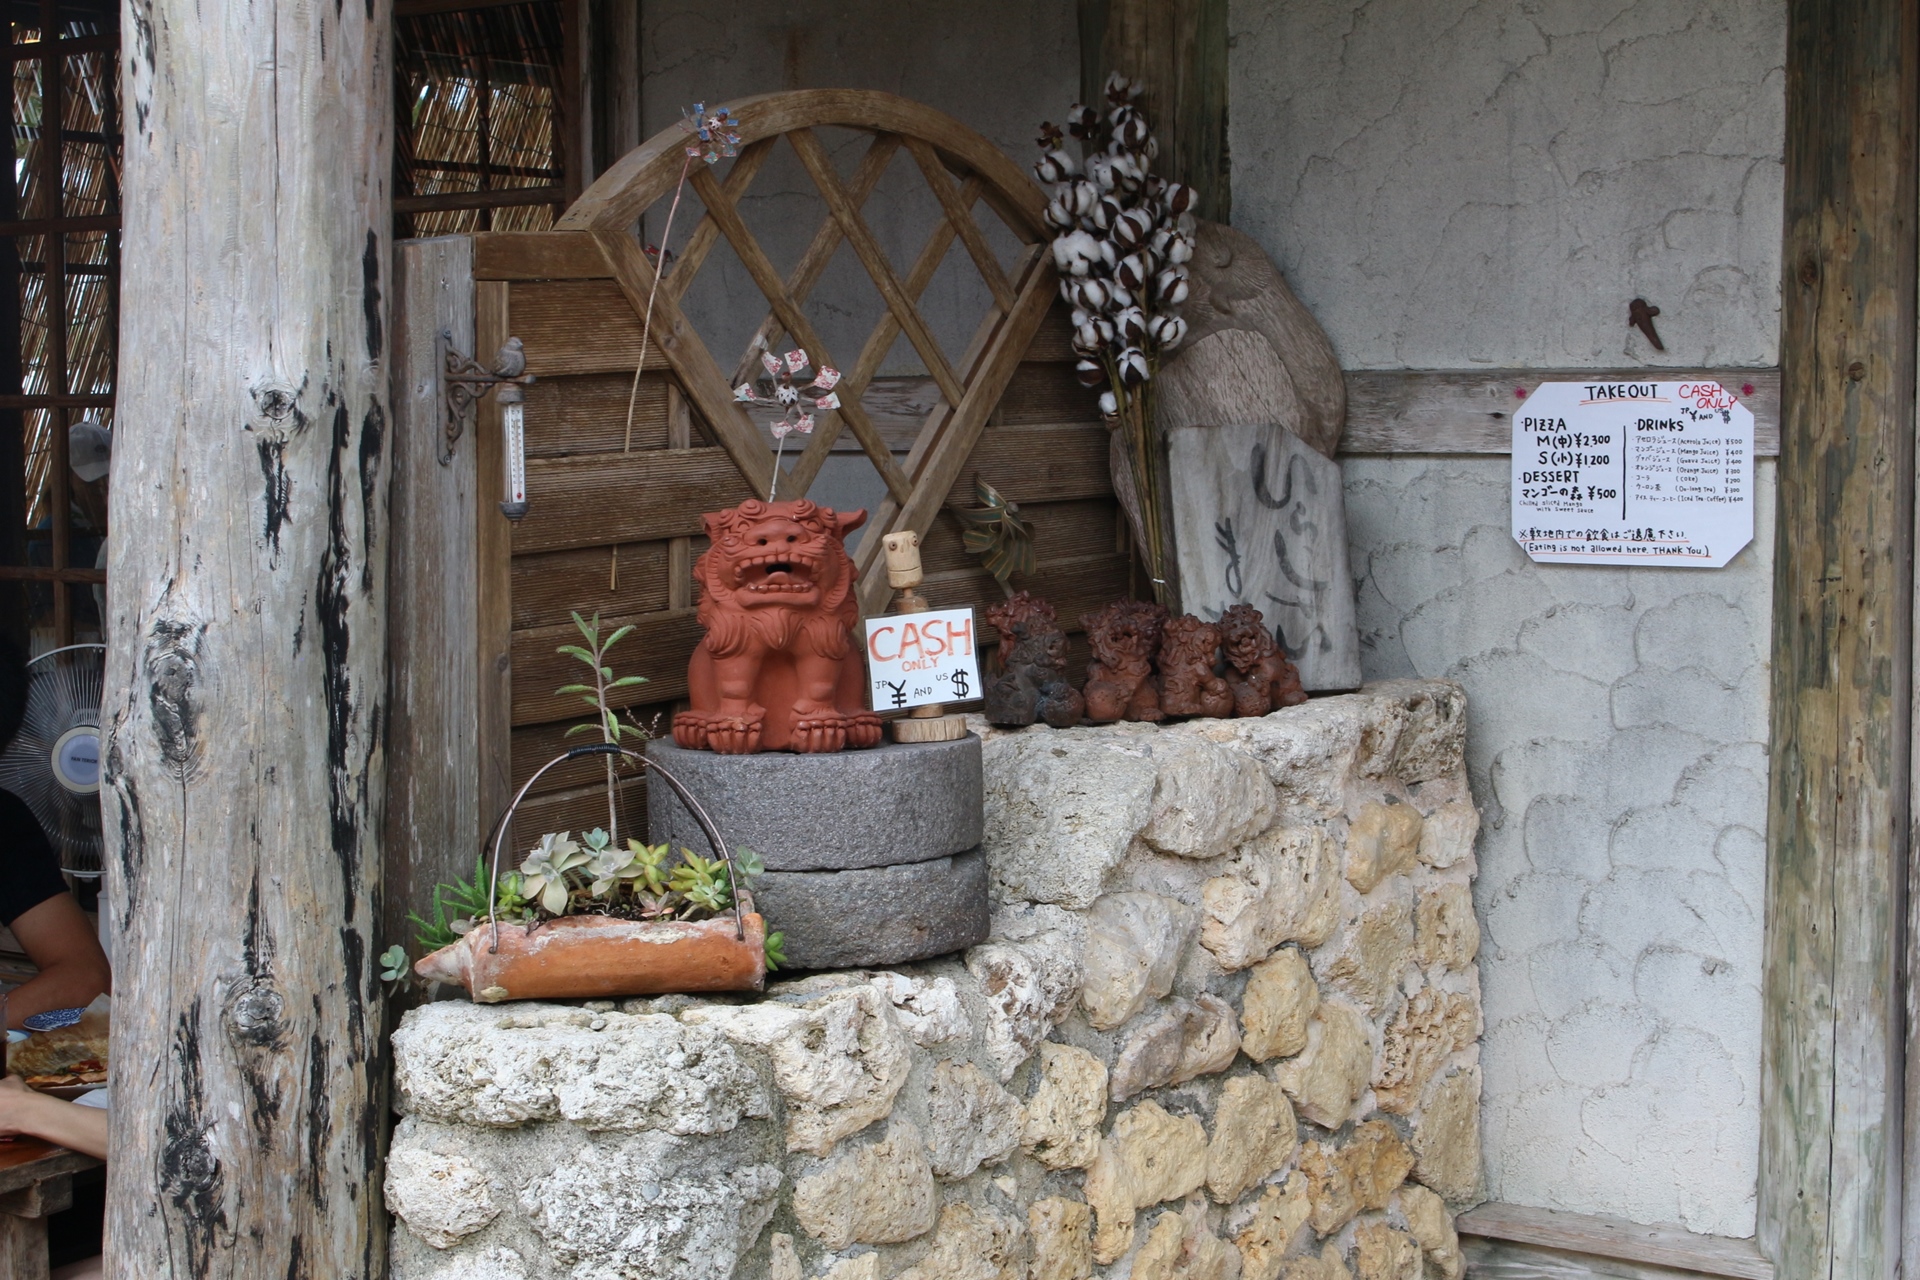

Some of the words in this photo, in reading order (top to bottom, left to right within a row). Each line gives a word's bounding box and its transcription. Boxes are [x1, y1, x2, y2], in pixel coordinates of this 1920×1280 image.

[1584, 384, 1658, 400] TAKEOUT
[1678, 384, 1723, 398] CASH
[1696, 396, 1737, 410] ONLY
[1524, 417, 1567, 433] PIZZA
[1523, 470, 1579, 484] DESSERT
[1587, 485, 1616, 500] ¥500
[1591, 544, 1622, 553] allowed
[868, 618, 971, 662] CASH
[901, 657, 939, 673] ONLY
[914, 687, 932, 698] AND
